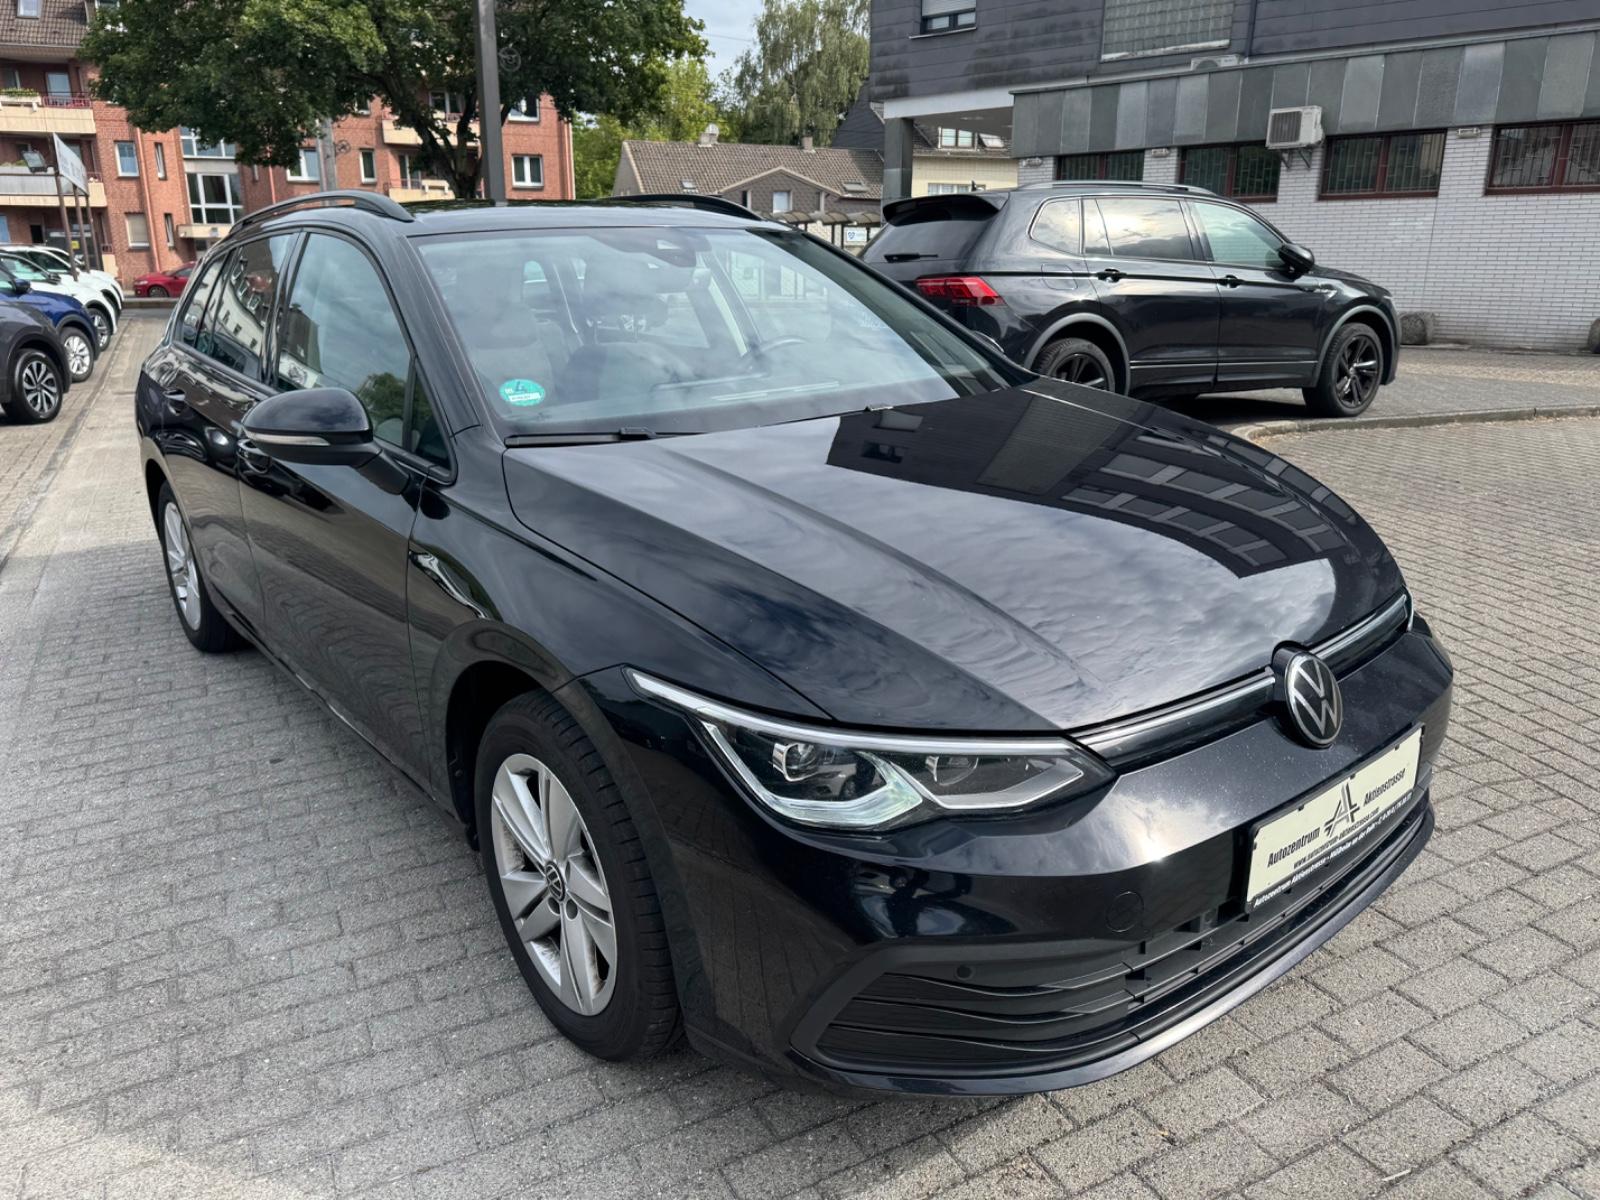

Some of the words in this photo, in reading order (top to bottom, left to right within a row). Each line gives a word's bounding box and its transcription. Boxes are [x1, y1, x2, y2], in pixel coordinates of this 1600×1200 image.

[1288, 656, 1340, 741] VW
[1363, 768, 1406, 807] Aktienstrasse
[1267, 827, 1321, 868] Autozentrum
[1253, 882, 1292, 908] Autozentrum
